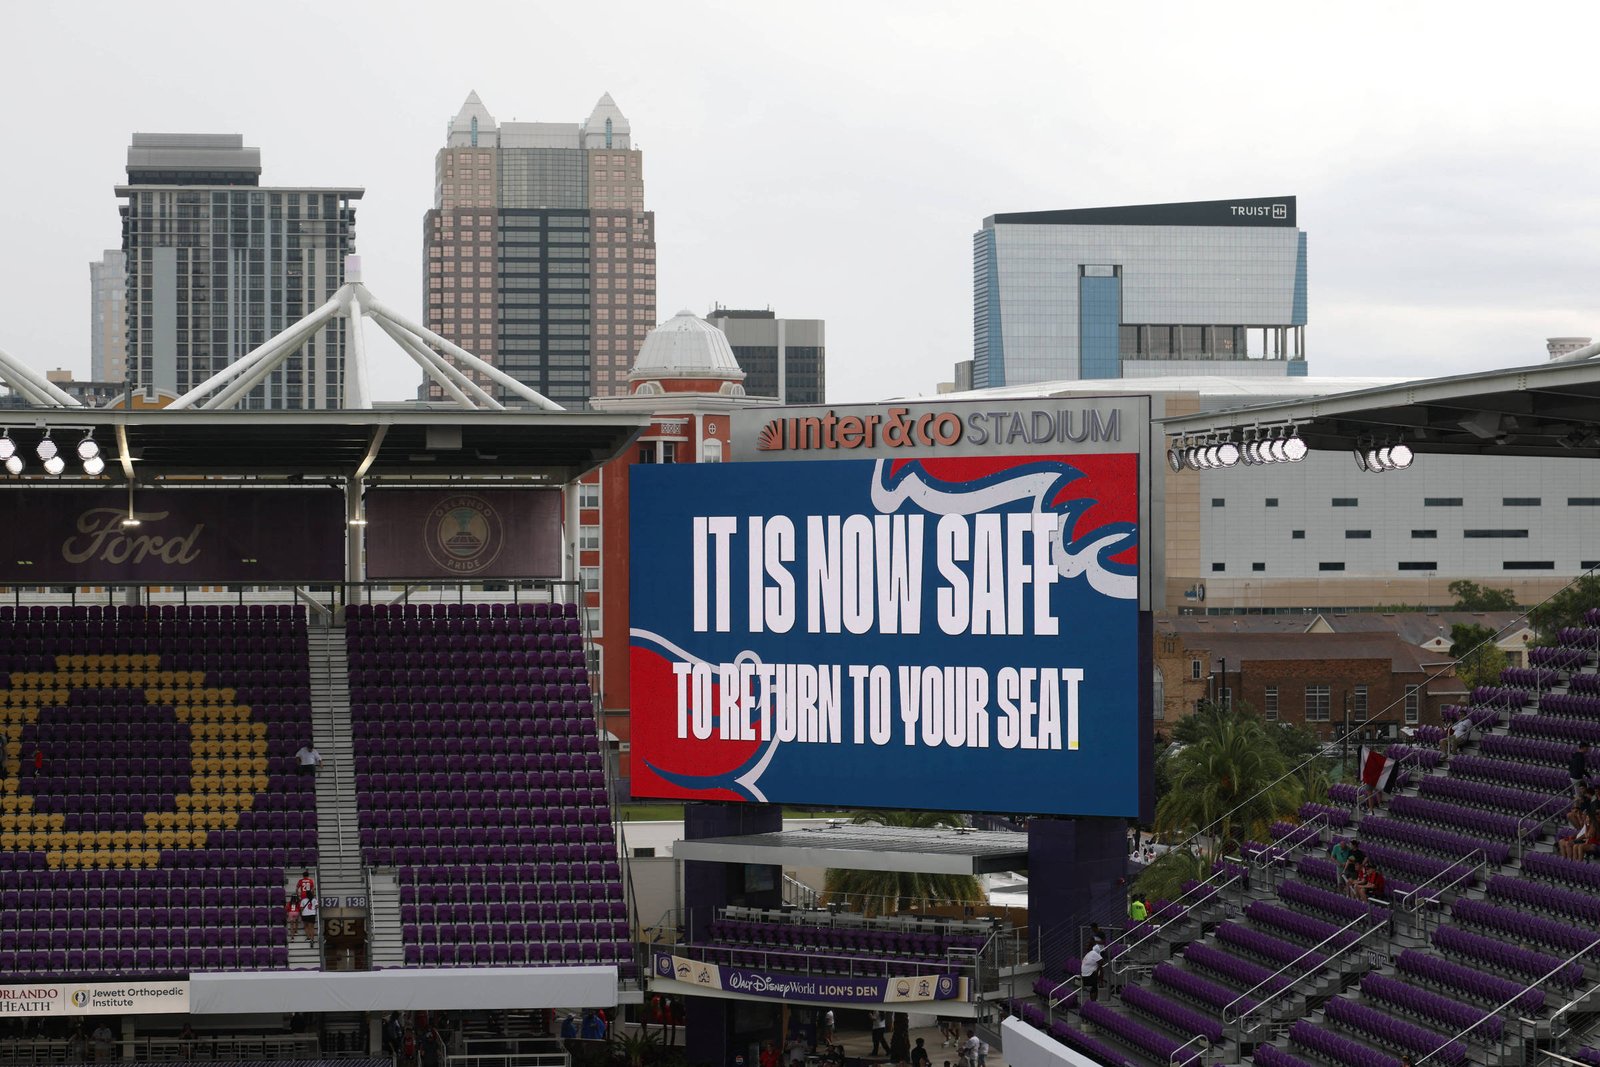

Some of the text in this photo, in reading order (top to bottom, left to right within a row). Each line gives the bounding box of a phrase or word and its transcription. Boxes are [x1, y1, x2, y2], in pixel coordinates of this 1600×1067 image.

[1231, 206, 1270, 216] TRUIST
[966, 408, 1121, 446] STADIUM
[435, 499, 492, 517] ORLANDO
[62, 507, 205, 564] Ford
[447, 559, 481, 570] PRIDE
[693, 512, 1059, 636] IT IS NOW SAFE
[672, 662, 1084, 751] TO RETURN TO YOUR SEAT
[320, 897, 339, 908] 137
[347, 897, 365, 908] 138
[327, 919, 356, 936] SE
[92, 987, 184, 998] Jewett Orthopedic
[789, 981, 815, 995] World
[819, 985, 853, 996] LION'S
[856, 986, 878, 997] DEN
[92, 998, 134, 1008] Institute
